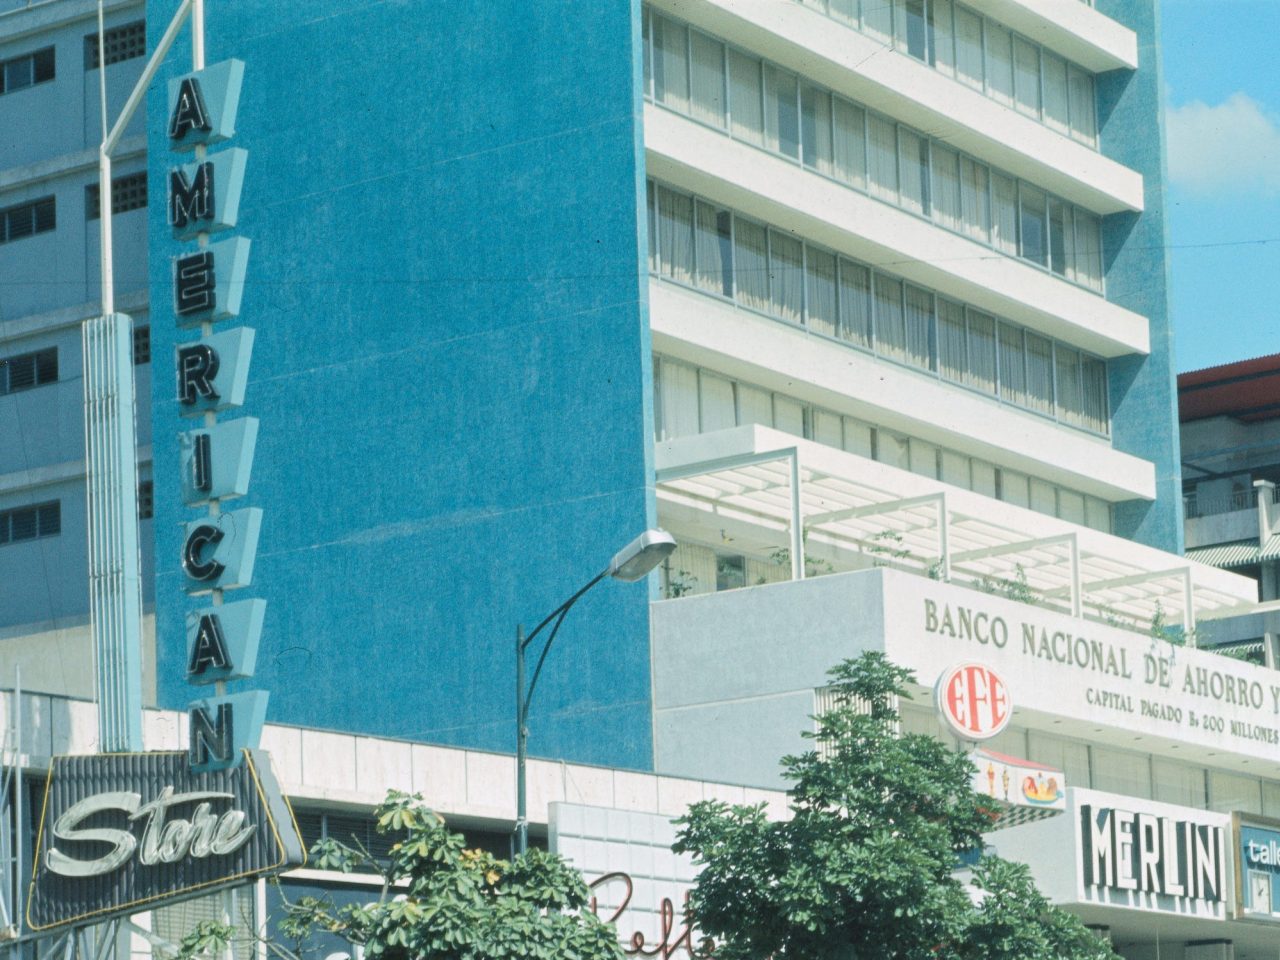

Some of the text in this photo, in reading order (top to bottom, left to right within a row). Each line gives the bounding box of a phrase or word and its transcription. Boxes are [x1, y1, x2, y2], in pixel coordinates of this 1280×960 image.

[168, 76, 235, 766] AMERICAN
[924, 598, 1009, 649] BANCO
[1020, 622, 1133, 680] NACIONAL
[1143, 653, 1171, 689] DE
[1182, 663, 1264, 710] AHORRO
[946, 664, 1007, 732] EFE
[1085, 687, 1135, 714] CAPITAL
[1140, 699, 1183, 724] PAGADO
[1203, 717, 1225, 734] 200
[1230, 719, 1280, 745] MILLONES
[46, 785, 257, 877] Store
[1084, 803, 1228, 903] MERLIN
